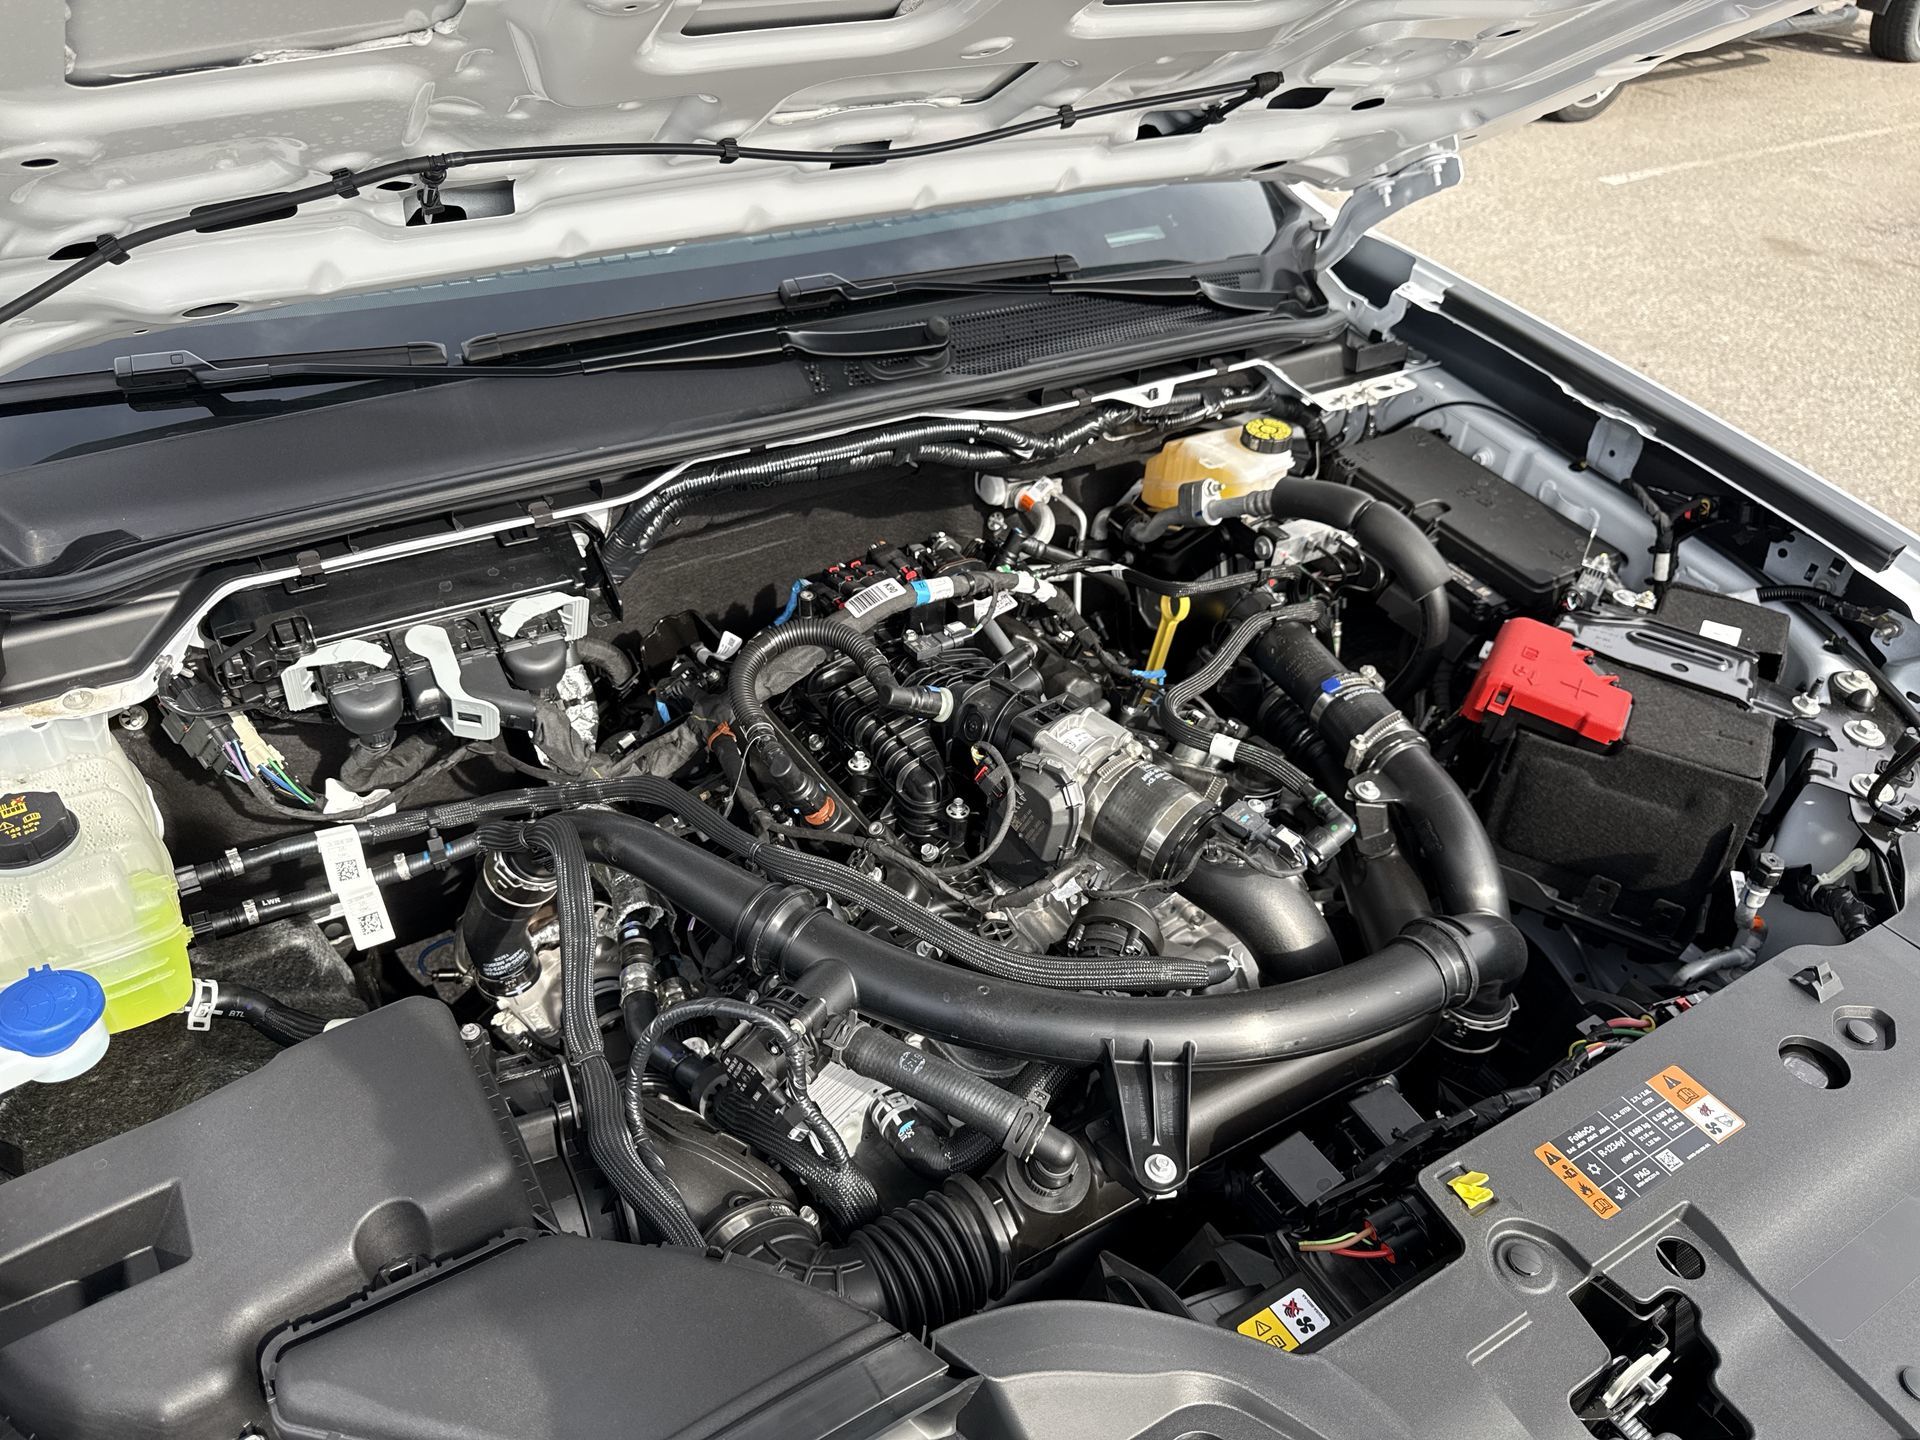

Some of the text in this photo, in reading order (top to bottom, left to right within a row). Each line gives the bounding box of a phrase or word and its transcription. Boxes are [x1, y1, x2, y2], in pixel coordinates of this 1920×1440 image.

[262, 897, 281, 907] LWR
[1568, 1125, 1595, 1143] FoMoCo
[1633, 1168, 1650, 1181] PAG
